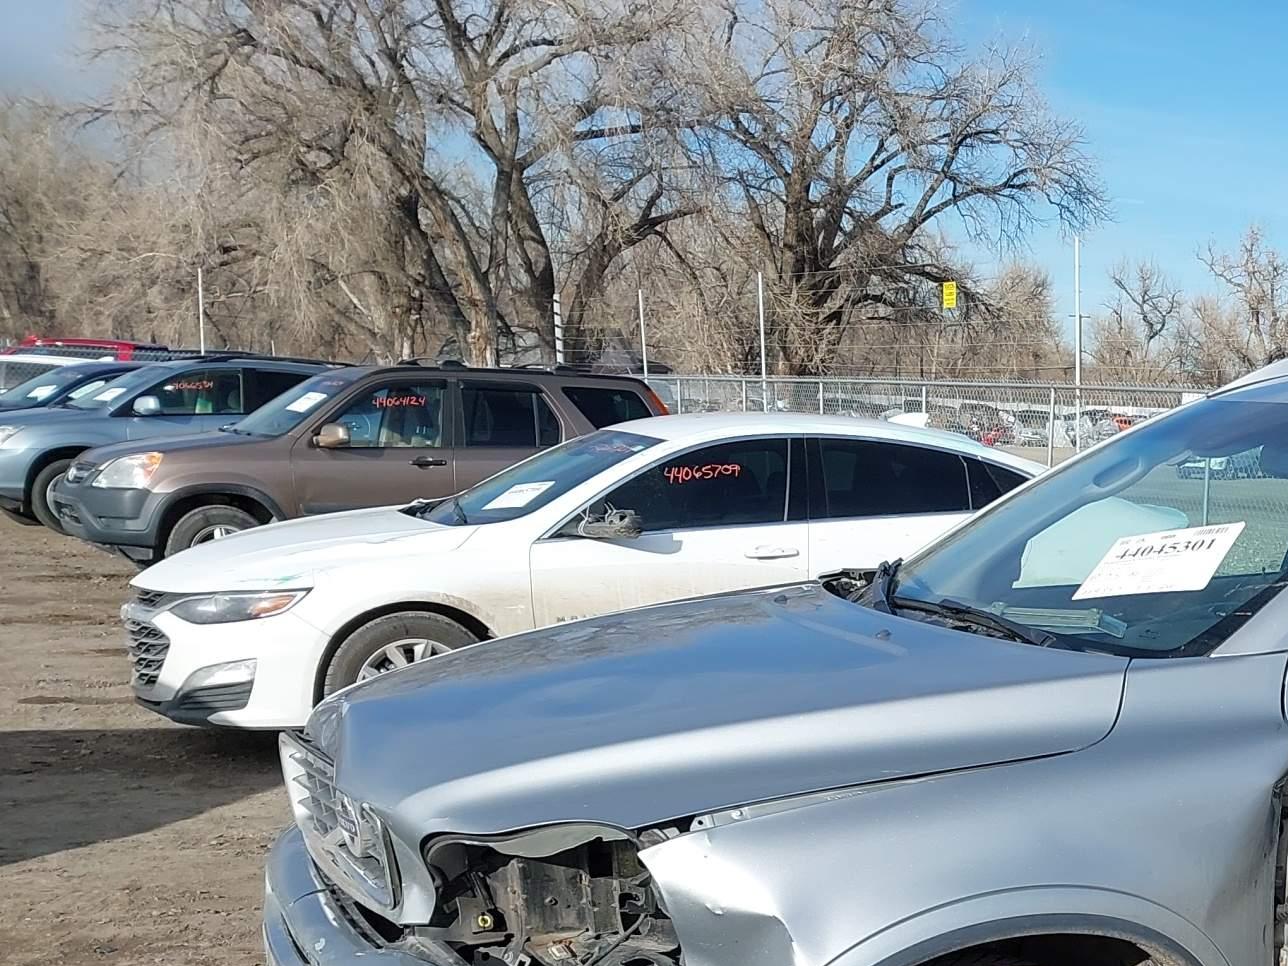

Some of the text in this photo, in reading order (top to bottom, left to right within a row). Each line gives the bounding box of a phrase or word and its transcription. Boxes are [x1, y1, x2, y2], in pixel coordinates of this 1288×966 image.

[372, 396, 426, 408] 44064124
[663, 464, 741, 484] 44065709
[1116, 537, 1217, 560] 44045301
